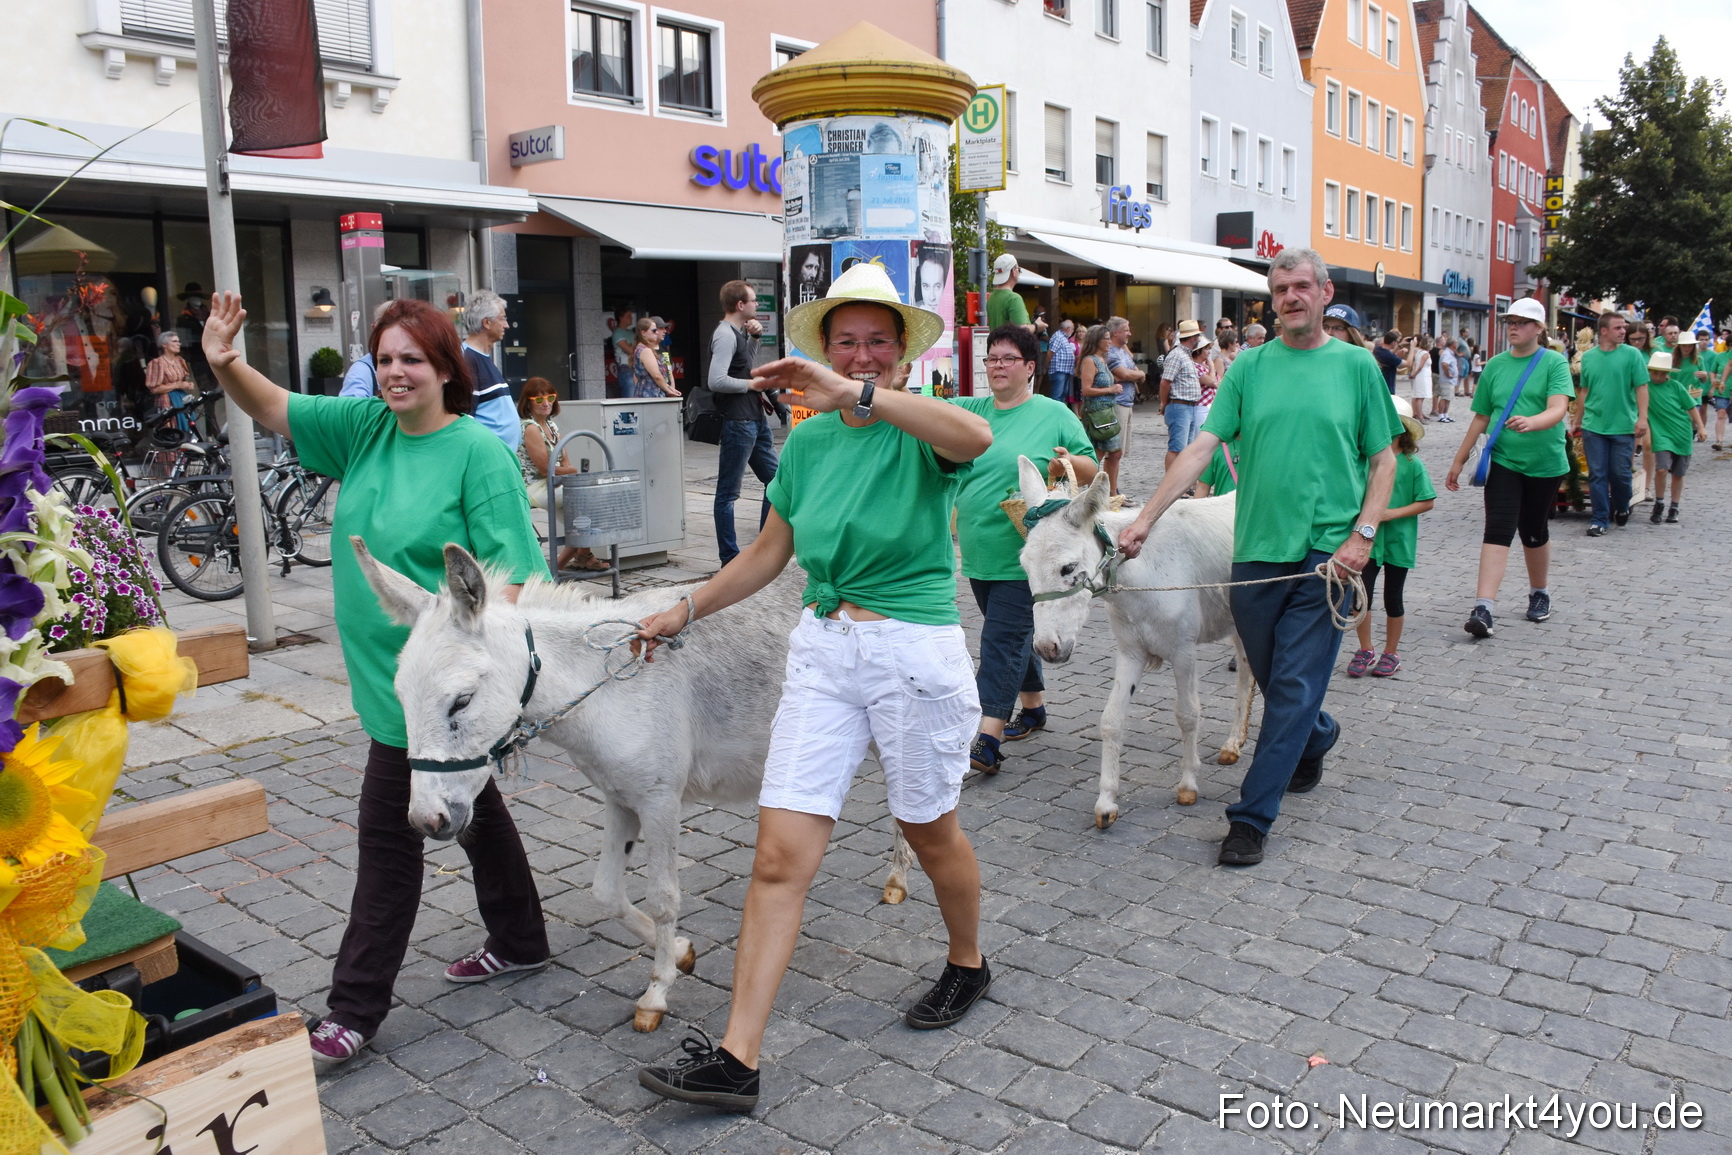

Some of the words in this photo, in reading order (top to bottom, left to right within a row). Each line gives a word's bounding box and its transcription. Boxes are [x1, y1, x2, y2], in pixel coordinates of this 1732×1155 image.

[972, 102, 989, 125] H
[827, 129, 866, 142] CHRISTIAN
[965, 137, 996, 146] Marktplatz
[827, 141, 864, 153] SPRINGER
[1107, 184, 1153, 229] fries
[1545, 177, 1563, 262] HOTE
